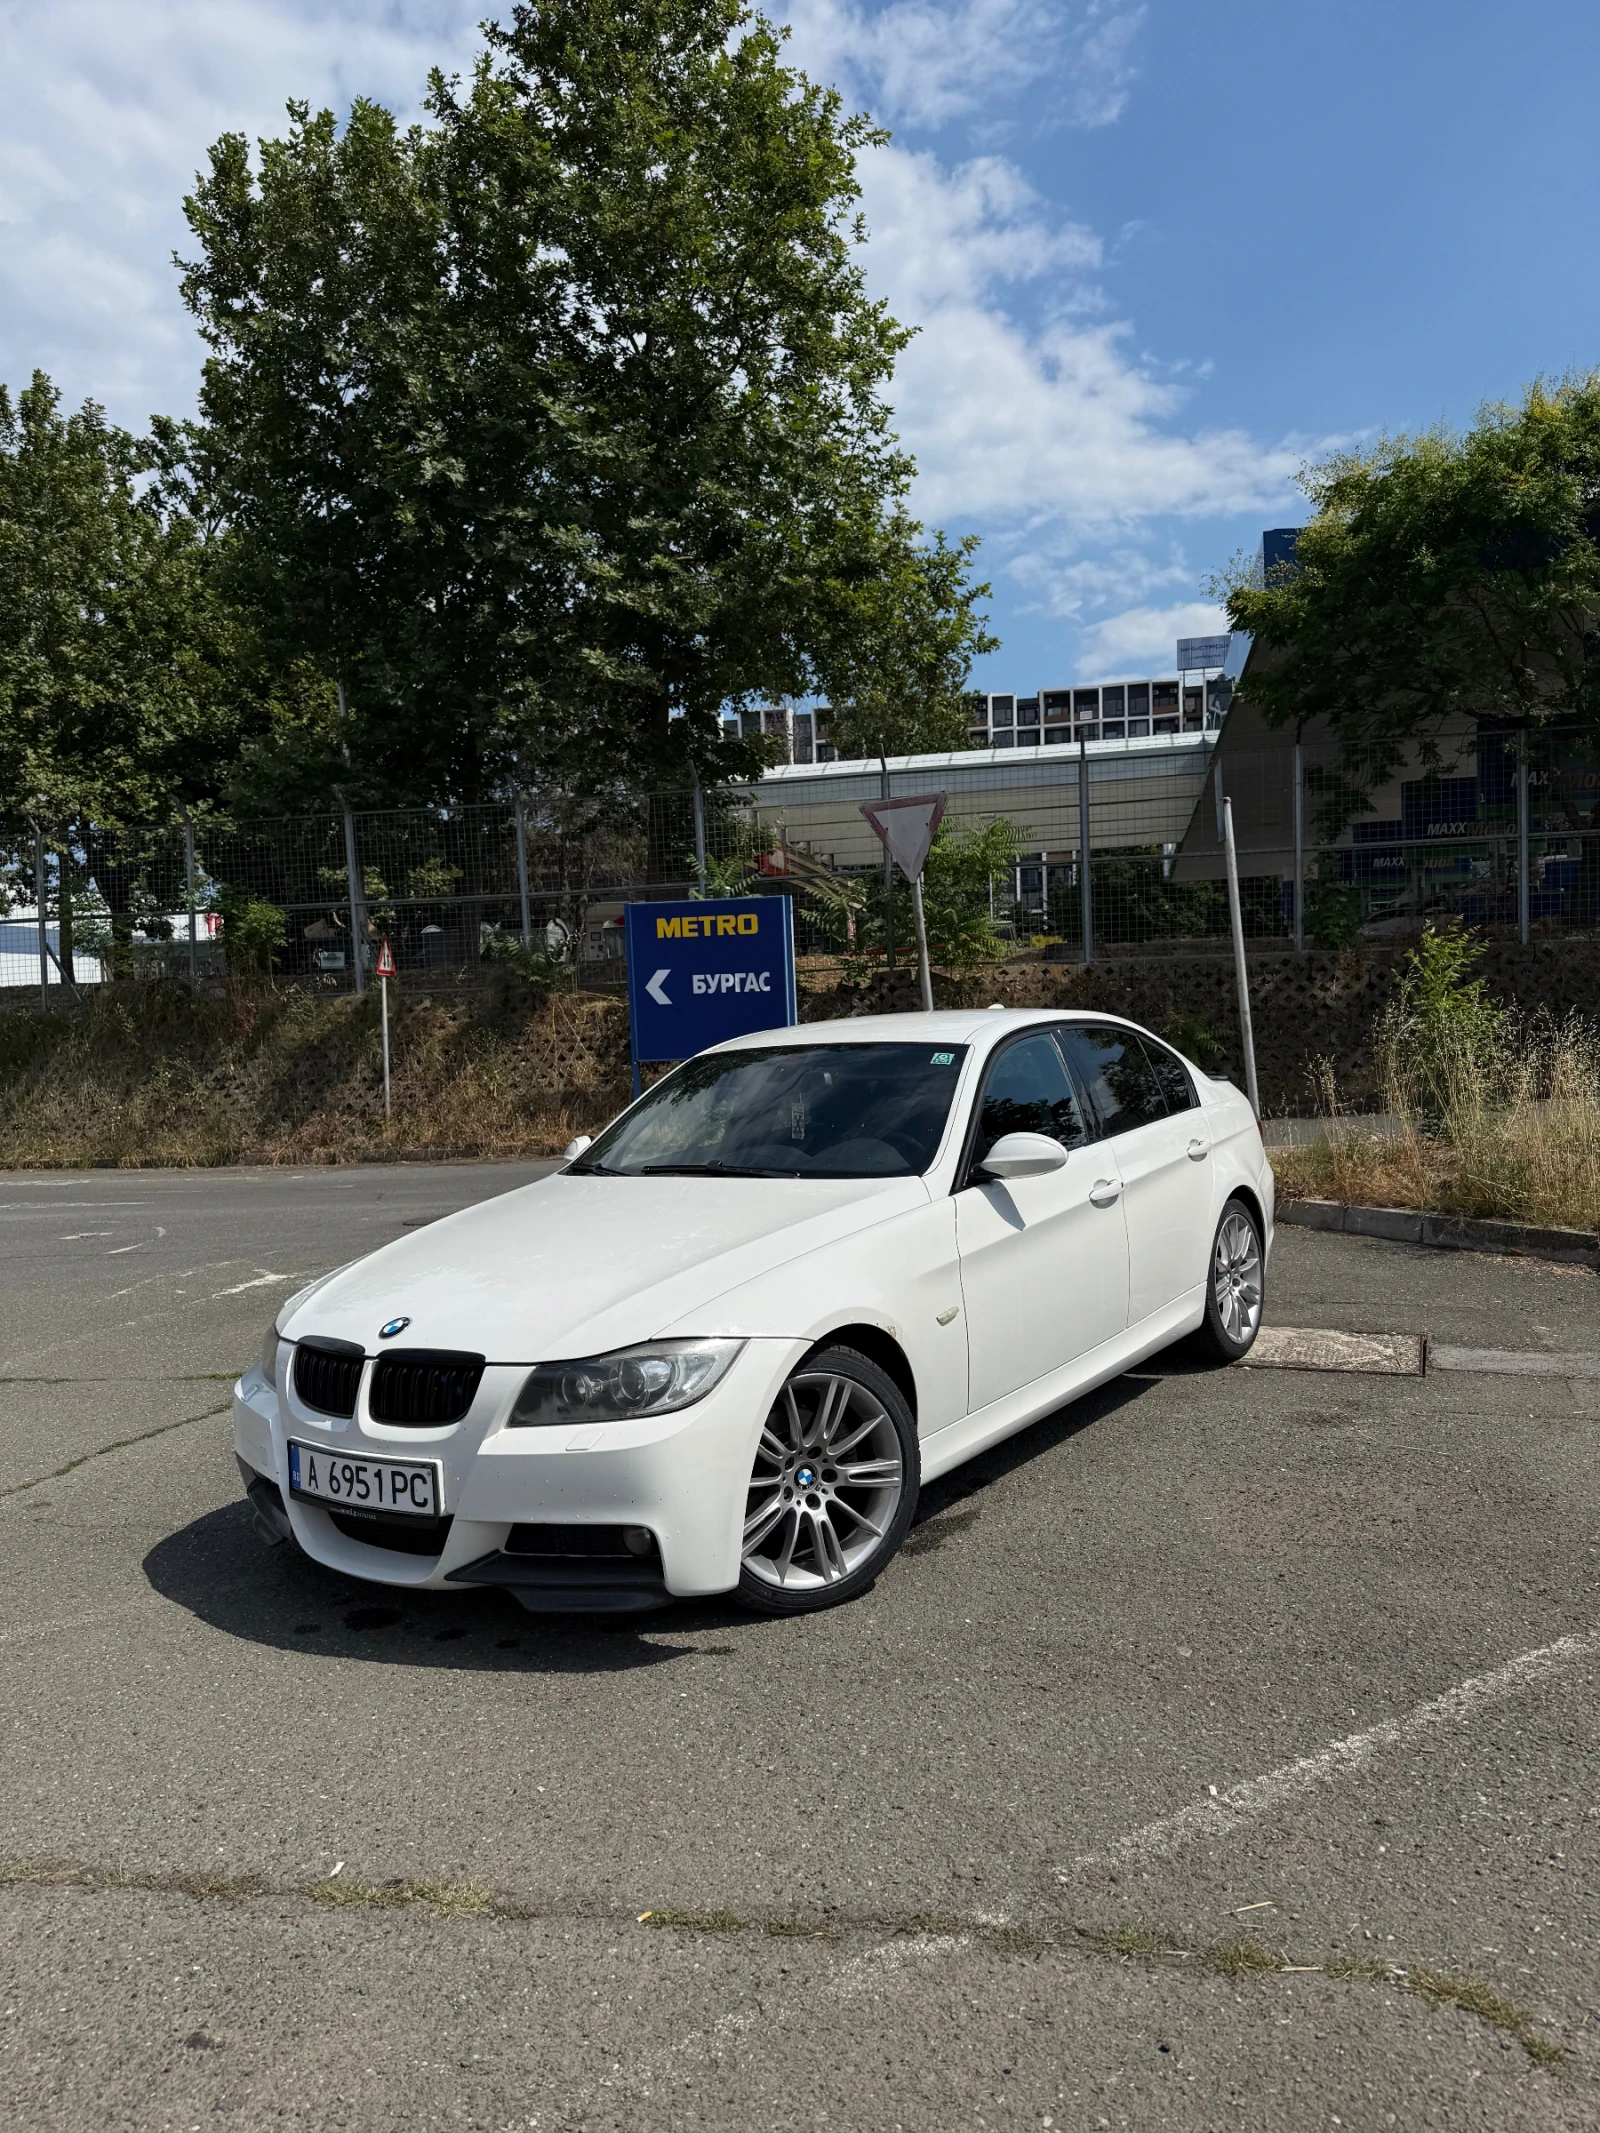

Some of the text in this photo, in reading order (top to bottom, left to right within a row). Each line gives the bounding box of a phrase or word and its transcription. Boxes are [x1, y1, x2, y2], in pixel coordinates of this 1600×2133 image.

[656, 913, 759, 939] METRO
[692, 971, 771, 995] БУРГАС
[292, 1470, 300, 1482] BG
[308, 1456, 428, 1508] A 6951 PC
